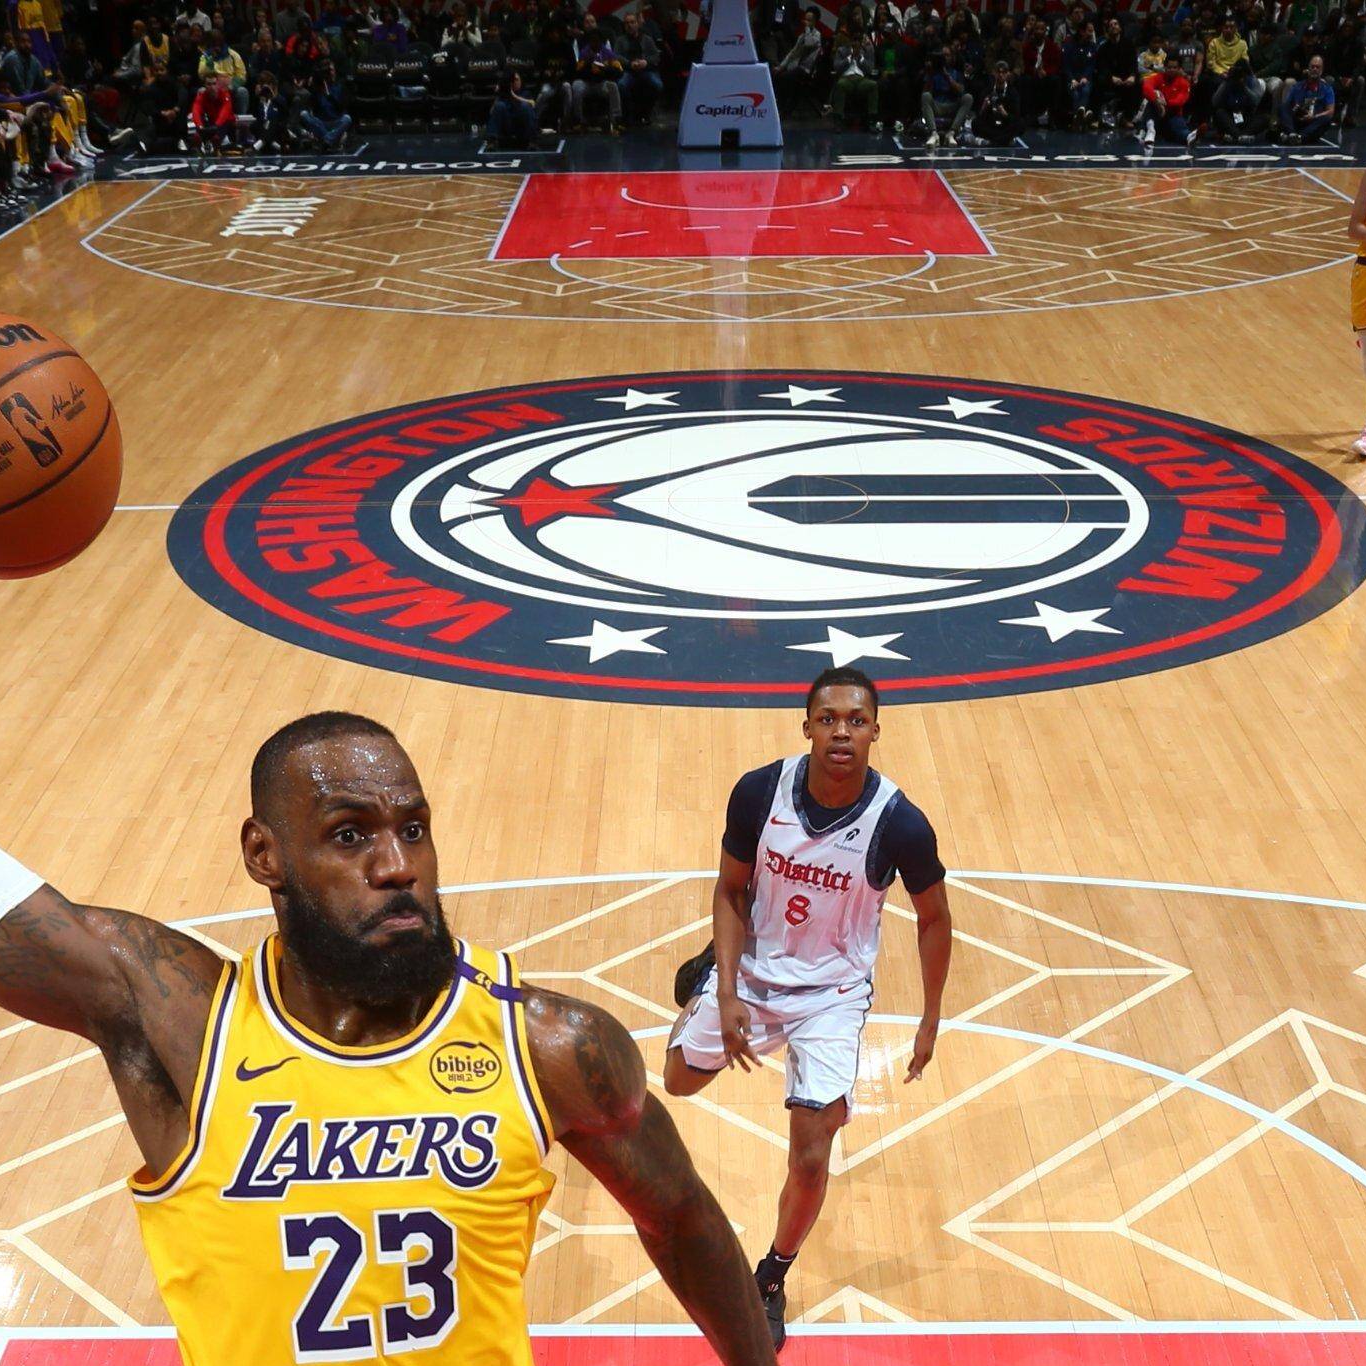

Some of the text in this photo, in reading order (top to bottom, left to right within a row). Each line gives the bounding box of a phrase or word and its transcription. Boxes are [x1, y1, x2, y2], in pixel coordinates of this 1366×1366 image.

[201, 158, 523, 174] Robinhood
[255, 402, 566, 643] WASHINGTON
[1037, 416, 1287, 601] WIZARDS
[765, 846, 853, 892] District
[785, 894, 812, 928] 8
[436, 1055, 497, 1078] bibigo
[448, 1073, 474, 1083] 비비고
[219, 1100, 501, 1201] LAKERS
[280, 1207, 460, 1364] 23
